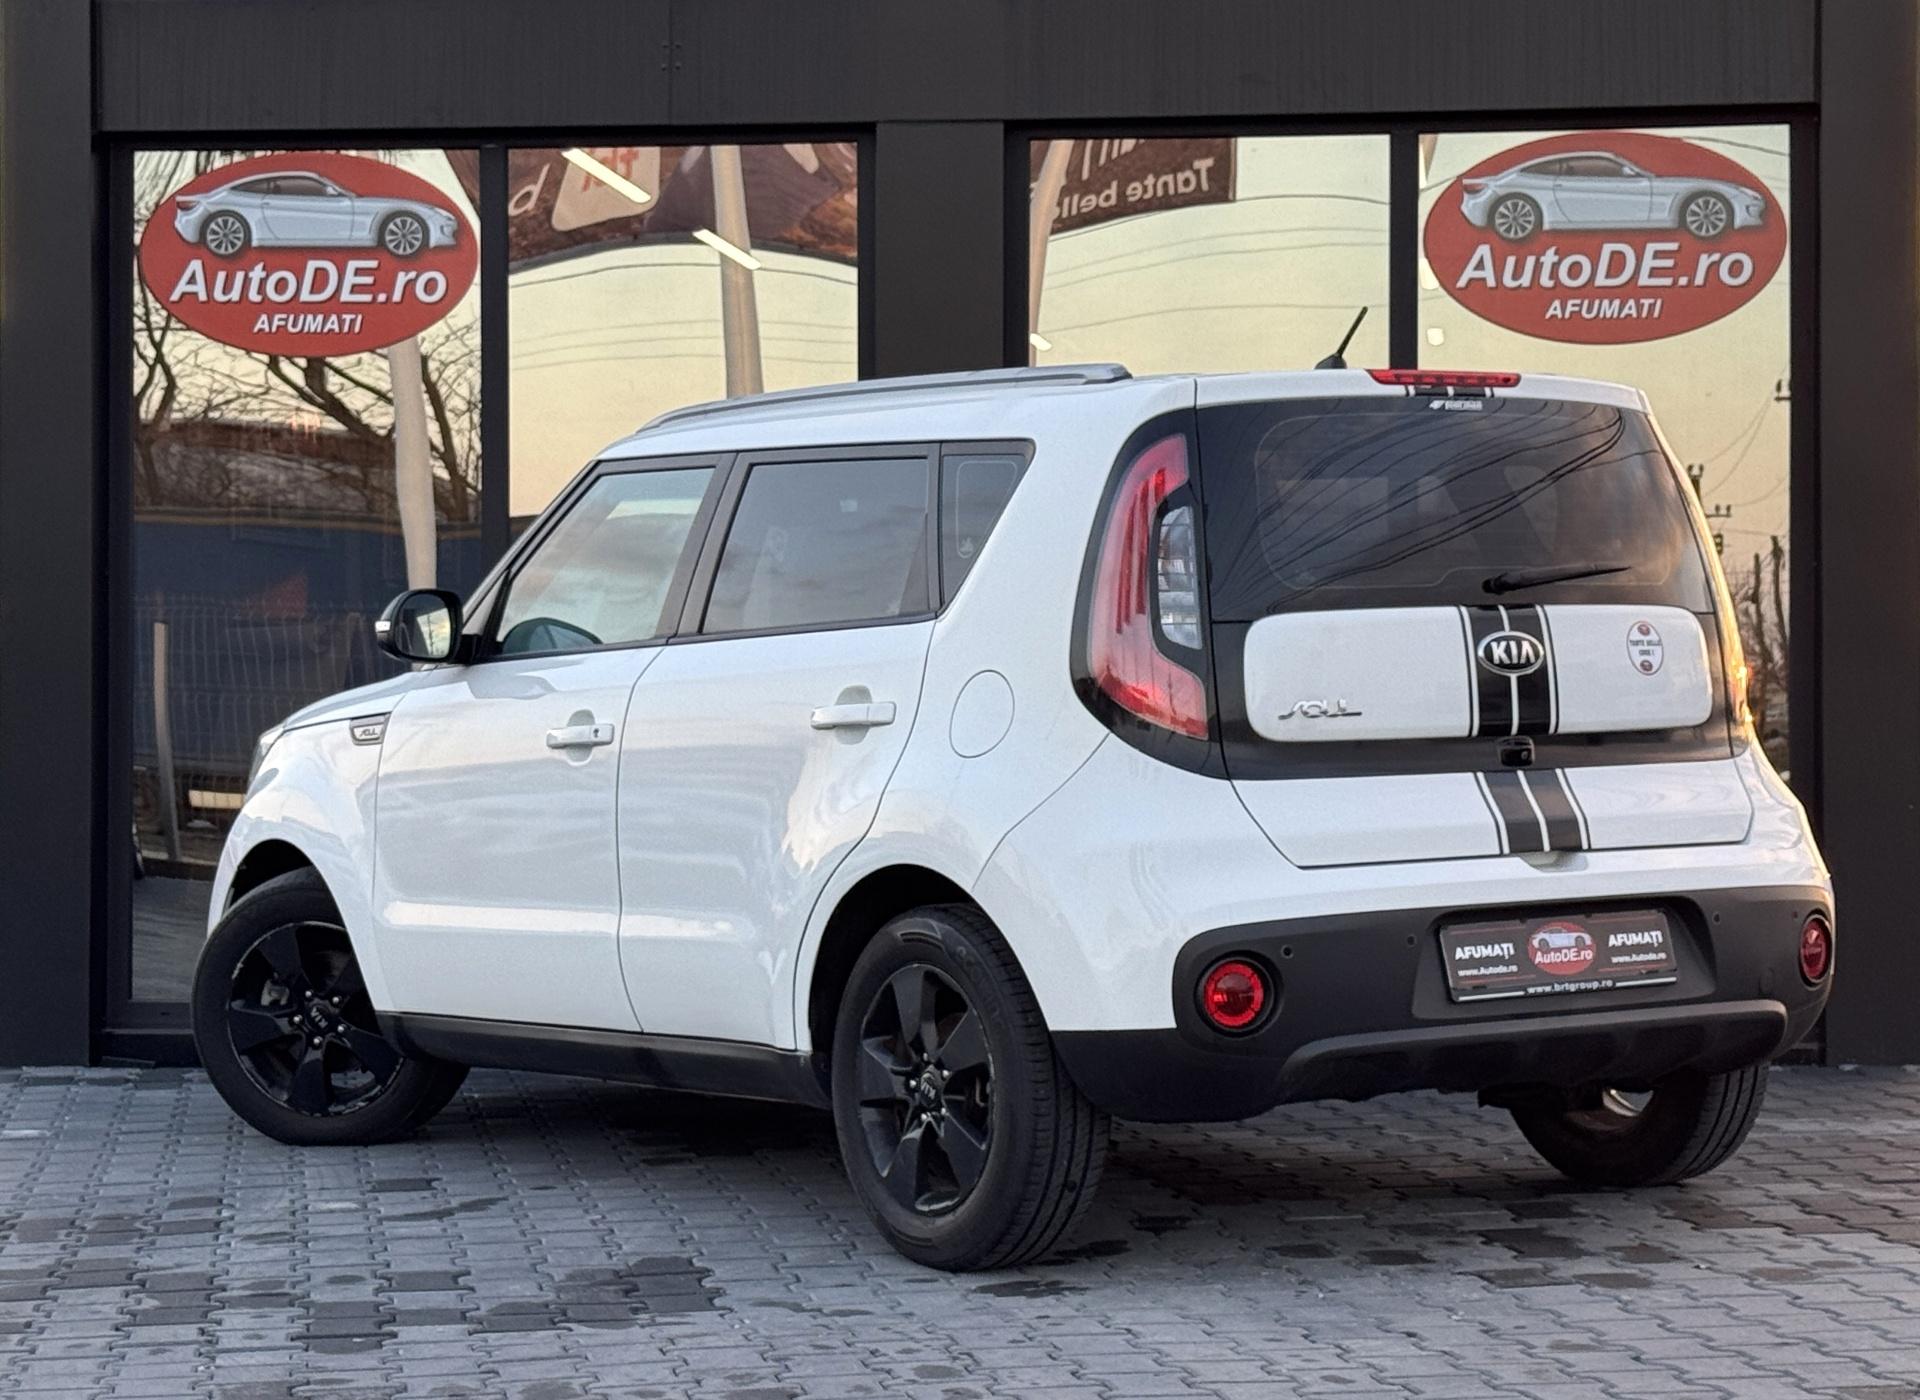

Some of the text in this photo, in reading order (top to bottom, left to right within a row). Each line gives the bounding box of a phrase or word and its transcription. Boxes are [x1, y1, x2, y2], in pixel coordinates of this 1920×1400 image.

[1456, 242, 1754, 289] AutoDE.ro
[170, 259, 449, 304] AutoDE.ro
[1545, 298, 1662, 320] AFUMATI
[253, 314, 363, 334] AFUMATI
[1490, 640, 1537, 665] KIA
[1534, 948, 1594, 966] AutoDE.ro
